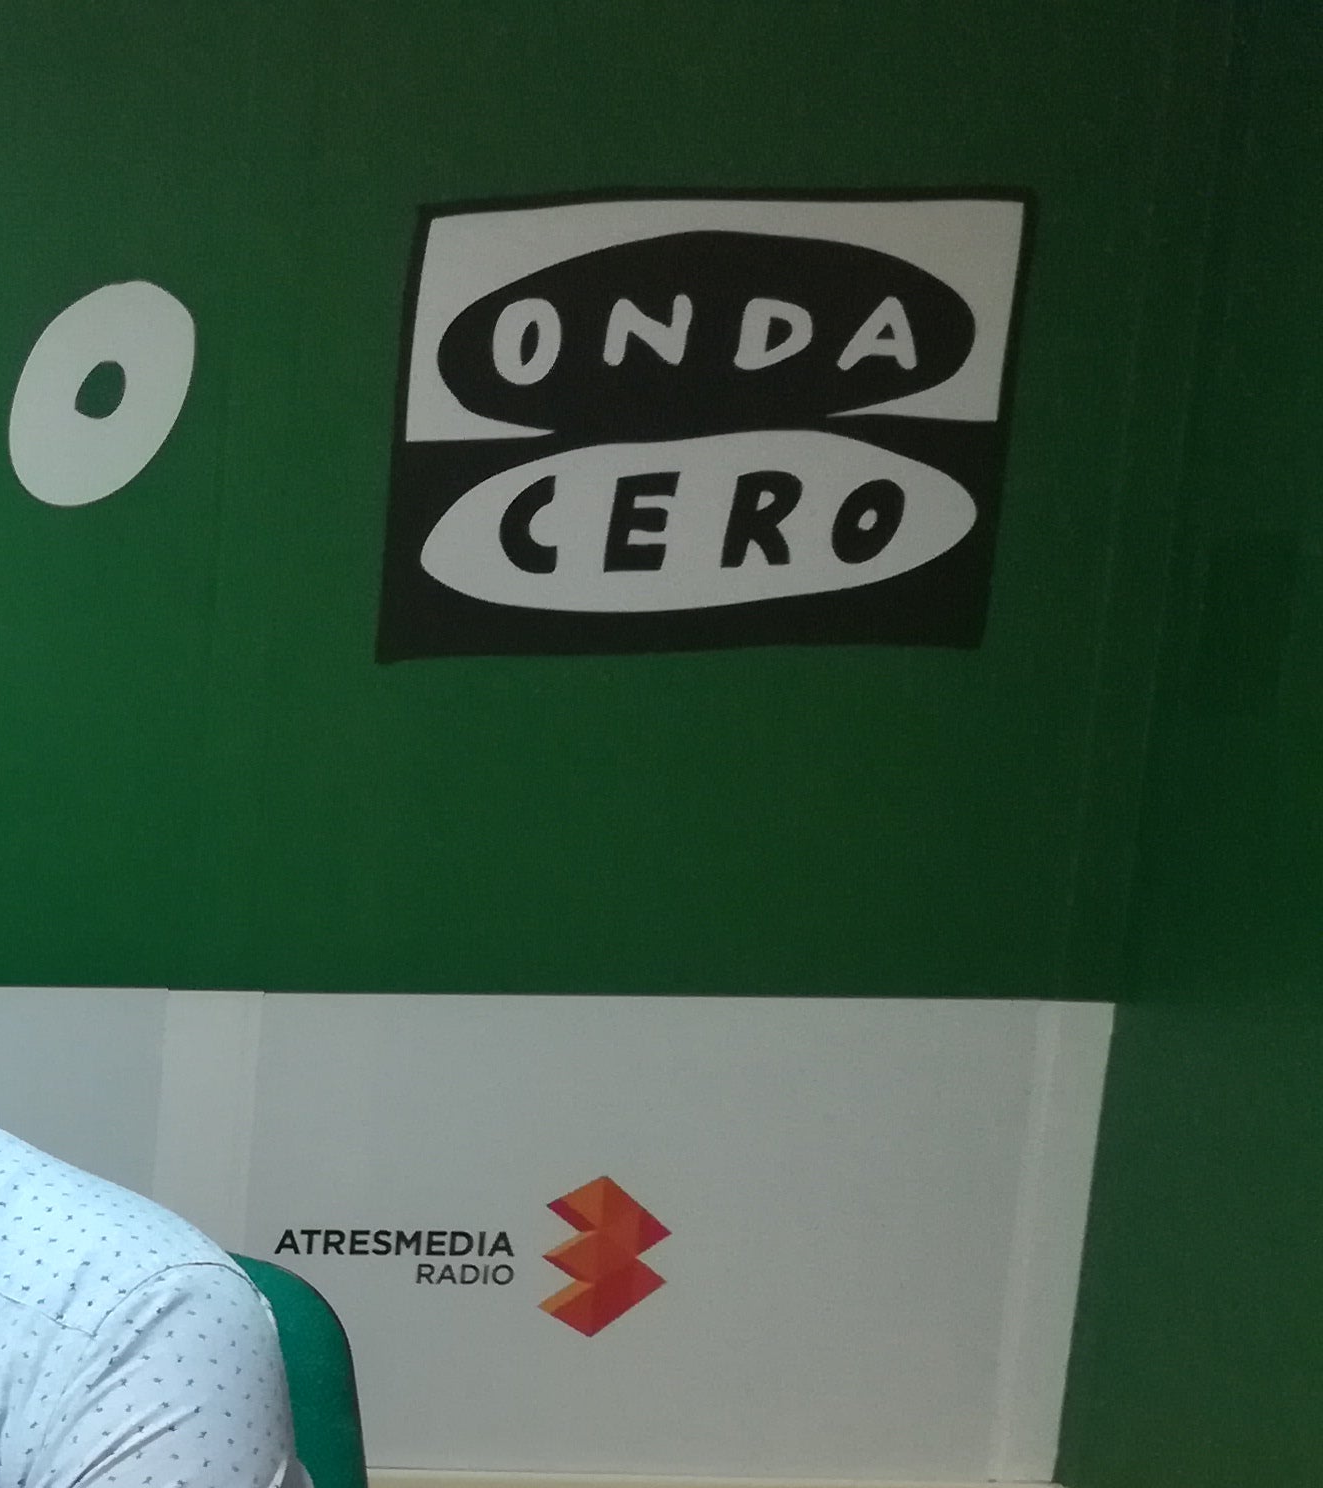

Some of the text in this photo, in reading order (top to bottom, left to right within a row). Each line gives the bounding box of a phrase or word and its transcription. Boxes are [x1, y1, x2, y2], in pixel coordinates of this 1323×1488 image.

[491, 293, 918, 386] ONDA
[499, 469, 906, 575] CERO
[274, 1229, 515, 1258] ATRESMEDIA
[415, 1263, 515, 1286] RADIO
